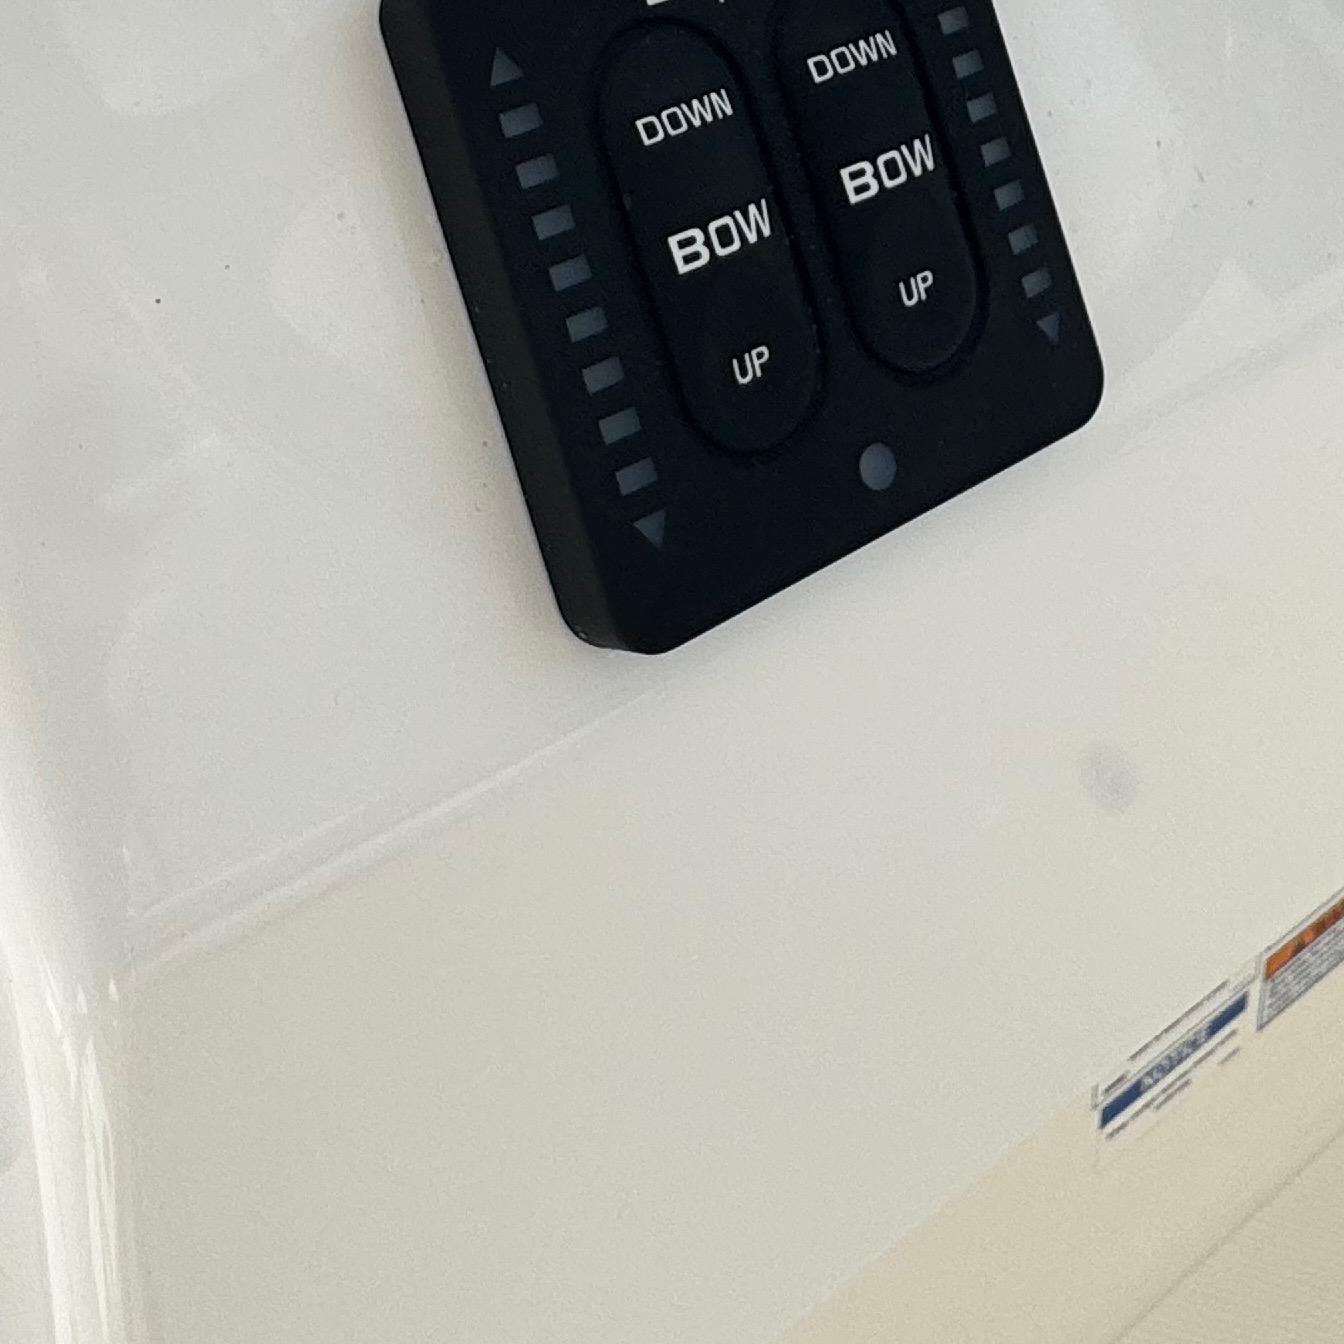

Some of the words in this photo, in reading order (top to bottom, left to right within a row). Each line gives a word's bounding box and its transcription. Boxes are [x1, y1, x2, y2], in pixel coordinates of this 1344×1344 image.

[806, 30, 899, 85] DOWN
[635, 89, 735, 148] DOWN
[840, 133, 937, 205] BOW
[667, 198, 774, 275] BOW
[900, 270, 935, 309] UP
[732, 345, 770, 386] UP
